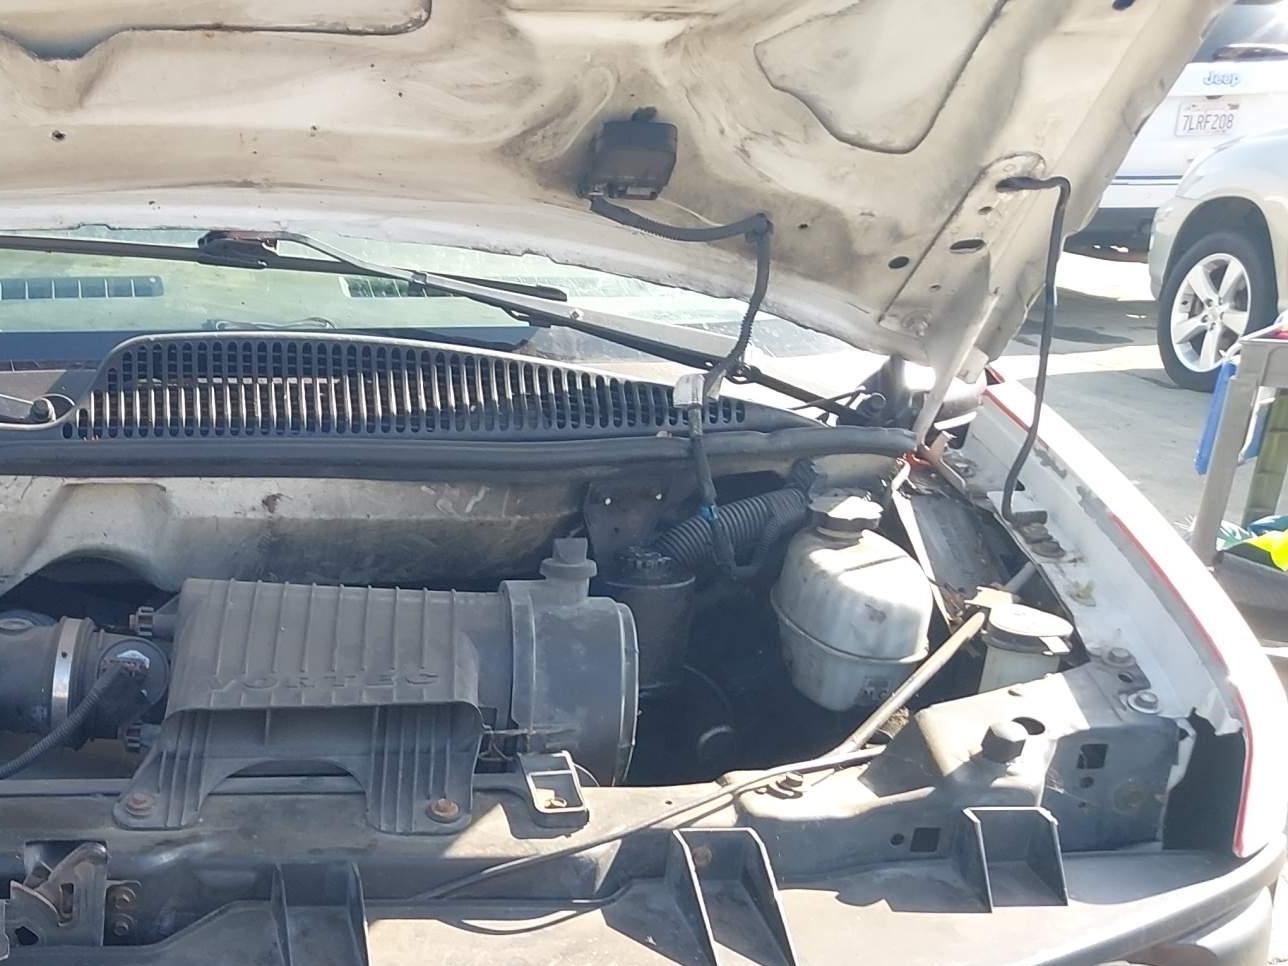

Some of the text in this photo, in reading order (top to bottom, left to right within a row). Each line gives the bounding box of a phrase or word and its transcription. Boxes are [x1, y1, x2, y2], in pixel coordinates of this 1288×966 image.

[1203, 71, 1241, 87] Jeep
[1183, 114, 1234, 130] 7LRF208
[208, 671, 440, 693] VORTEC
